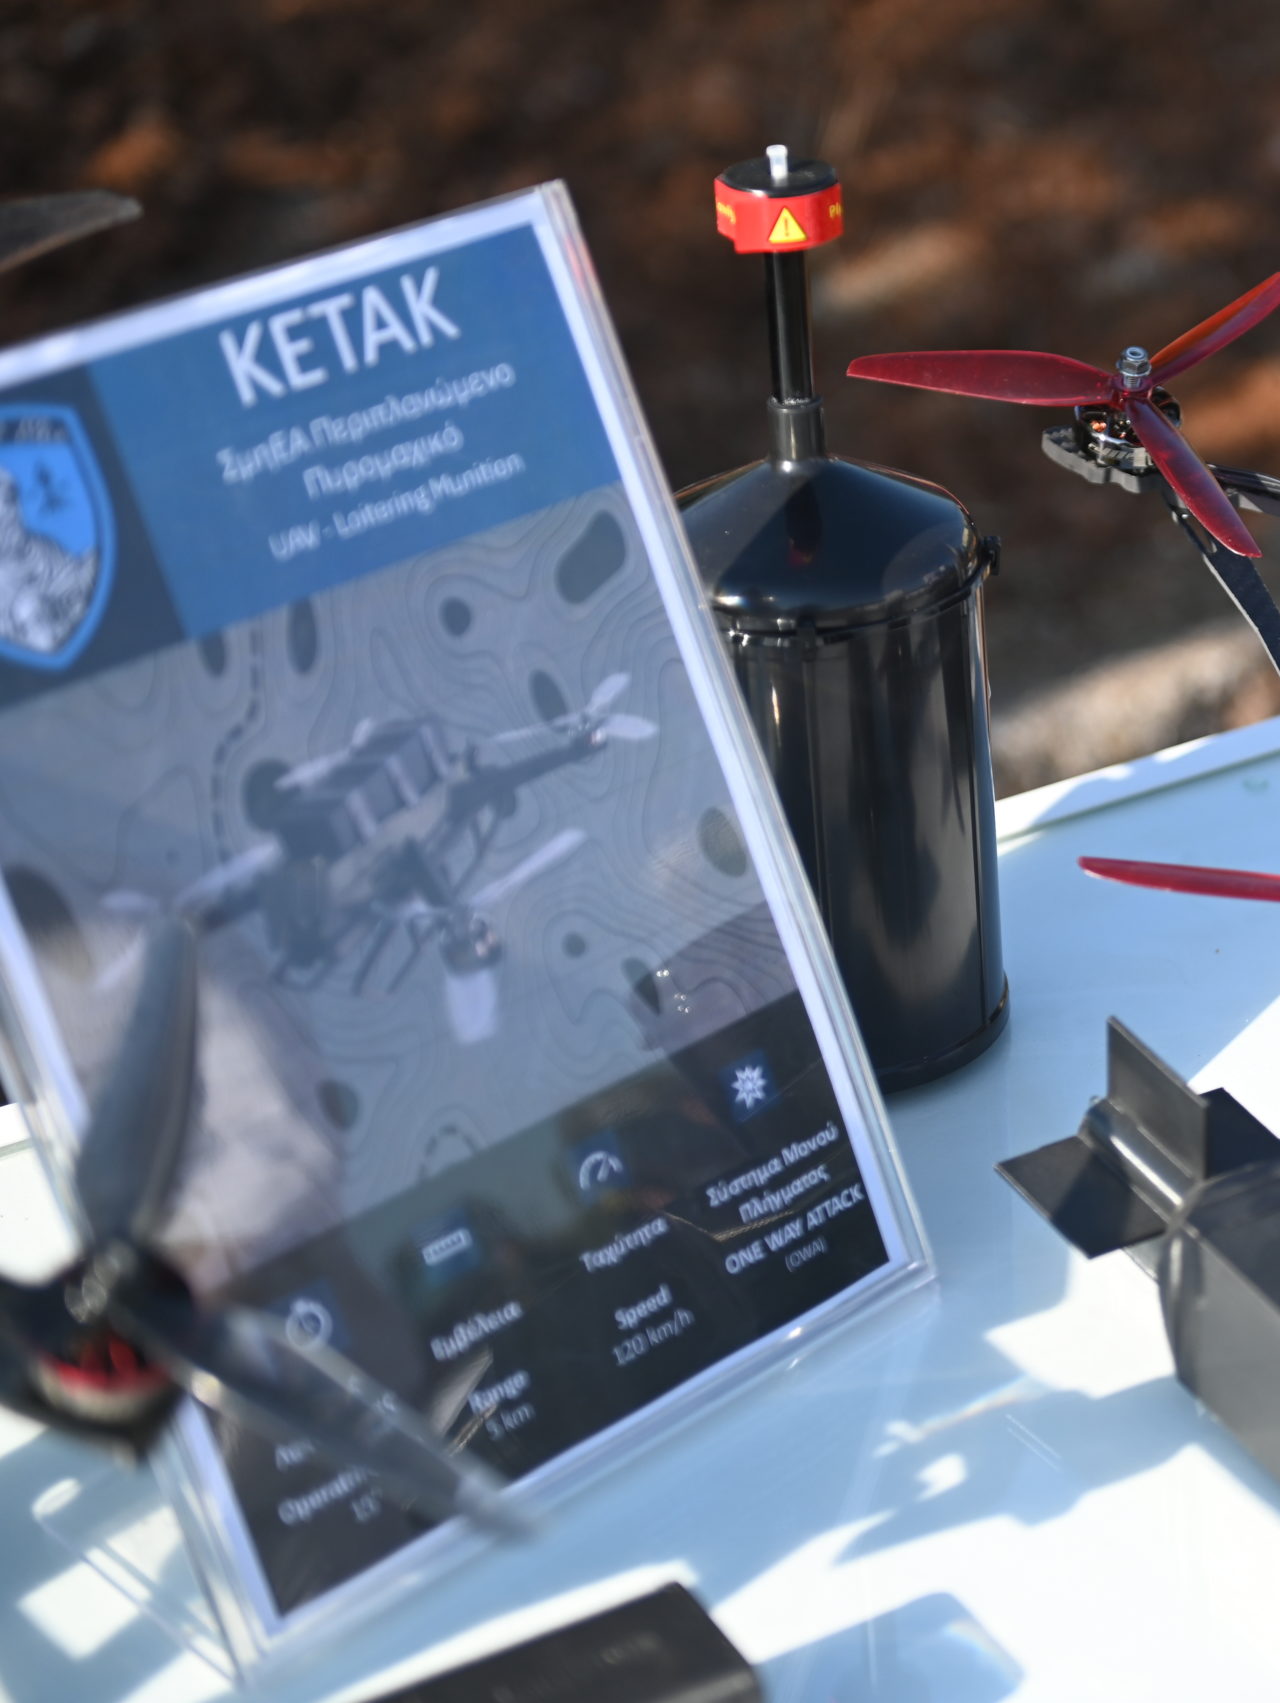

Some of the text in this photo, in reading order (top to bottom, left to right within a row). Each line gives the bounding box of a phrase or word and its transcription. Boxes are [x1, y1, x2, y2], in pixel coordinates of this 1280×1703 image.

[309, 362, 516, 445] Περιπλανώμενο
[302, 420, 464, 500] Πυρομαχικό
[268, 521, 321, 566] UAV
[332, 484, 437, 539] Loitering
[428, 452, 526, 502] Munition
[705, 1121, 839, 1208] Σύστημα Μονού
[738, 1163, 831, 1225] Πλήγματος
[578, 1216, 670, 1273] Ταχύτητα
[724, 1183, 866, 1276] ONE WAY ATTACK
[784, 1236, 828, 1273] (OWA)
[612, 1307, 696, 1367] 120 km/h
[613, 1282, 673, 1332] Speed
